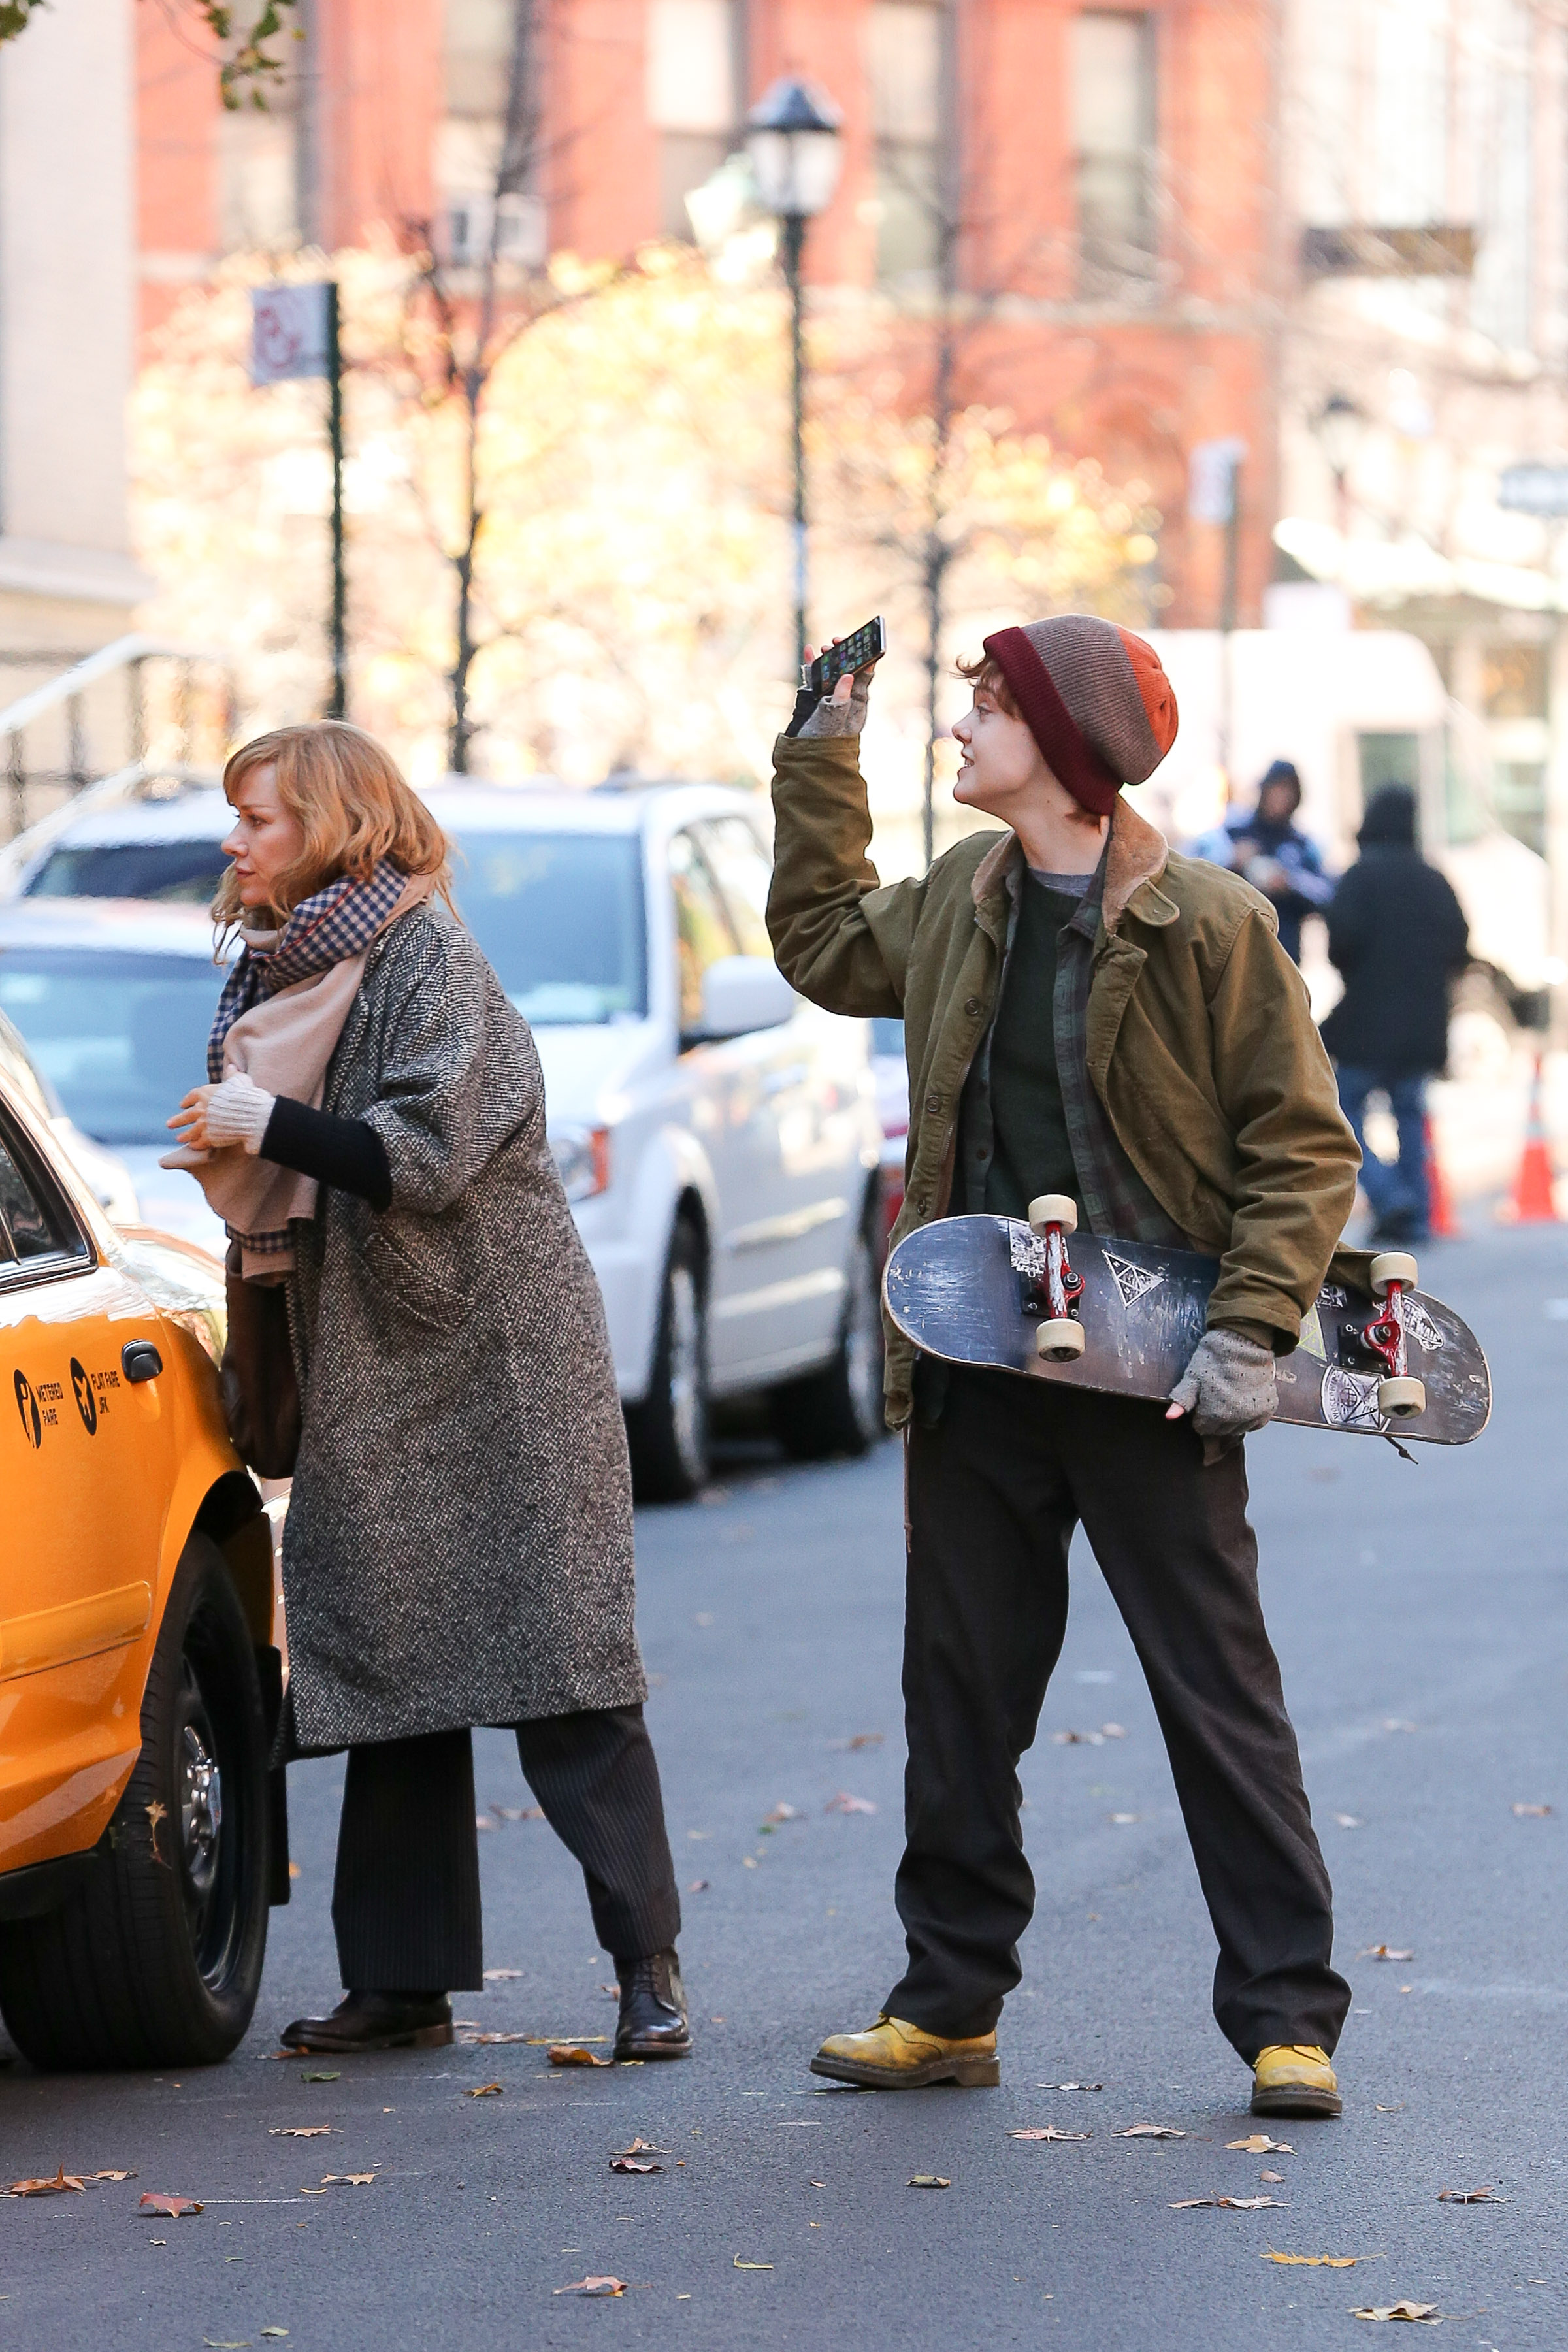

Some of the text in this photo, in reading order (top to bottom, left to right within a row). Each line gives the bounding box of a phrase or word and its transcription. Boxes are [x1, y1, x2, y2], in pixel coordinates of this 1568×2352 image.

[1416, 1320, 1438, 1342] WALL
[90, 1371, 120, 1390] FLAT FARE
[35, 1382, 63, 1403] METERED
[99, 1397, 110, 1414] JFK
[42, 1408, 58, 1427] FARE
